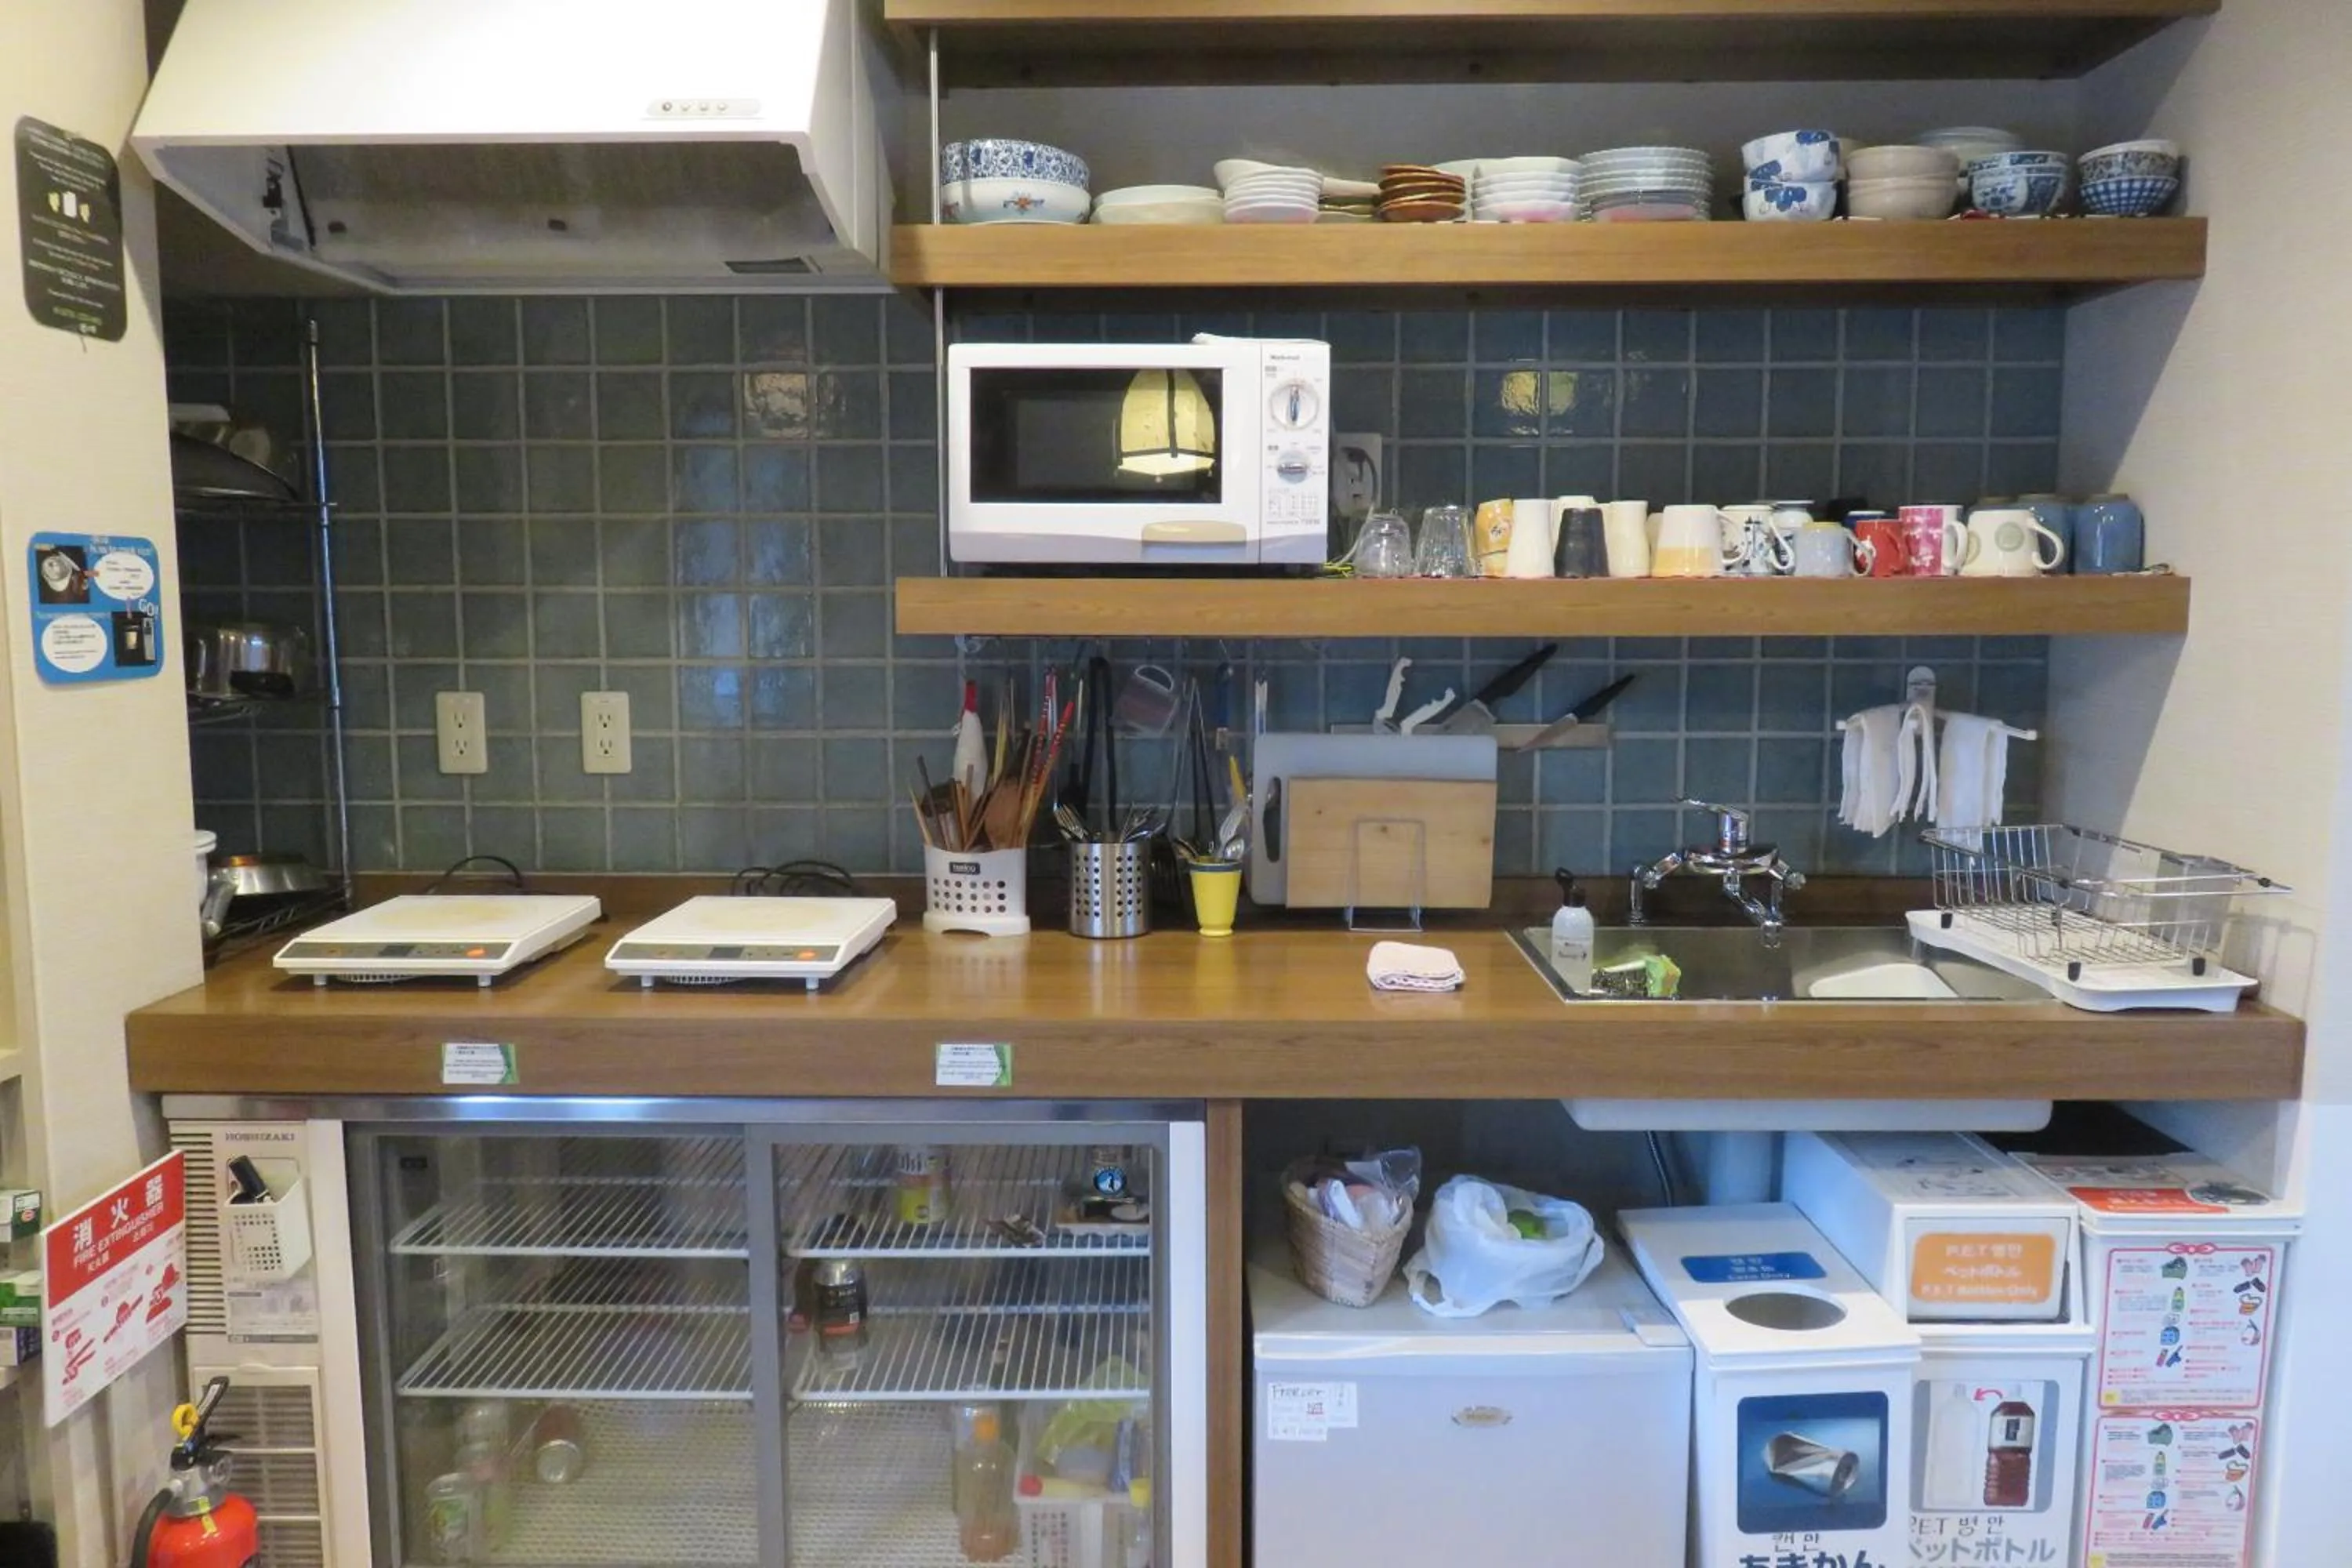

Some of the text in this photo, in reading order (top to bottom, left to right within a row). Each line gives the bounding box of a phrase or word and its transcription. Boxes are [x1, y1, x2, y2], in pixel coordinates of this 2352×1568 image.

[73, 1174, 163, 1254] 消火器
[74, 1243, 98, 1269] FIRE
[97, 1201, 164, 1253] EXTINGUISHER
[1909, 1537, 2056, 1563] ペットボトル
